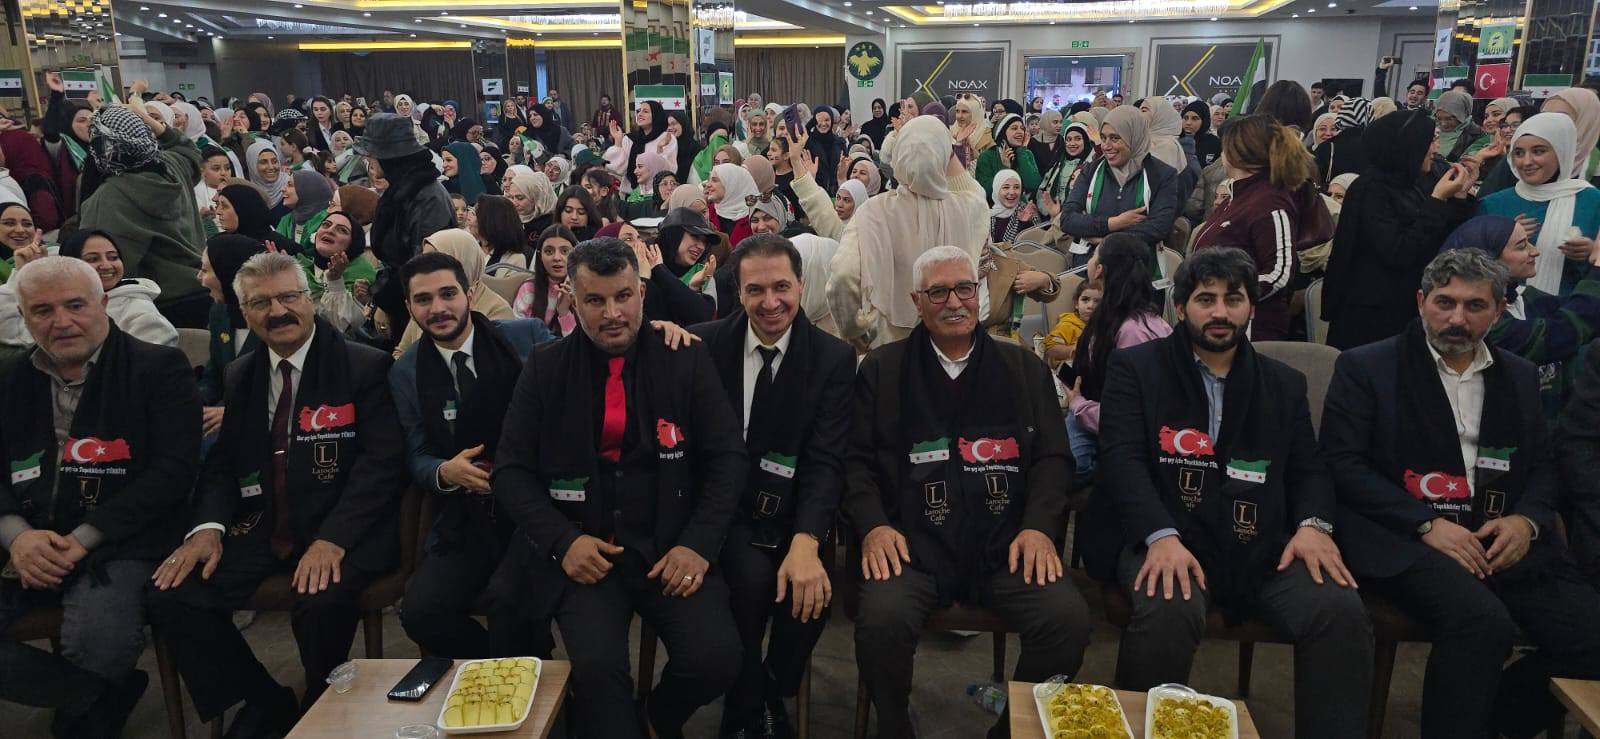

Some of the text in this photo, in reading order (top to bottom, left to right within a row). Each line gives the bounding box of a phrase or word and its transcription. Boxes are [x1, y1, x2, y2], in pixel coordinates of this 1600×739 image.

[948, 79, 989, 89] NOAX
[1209, 76, 1243, 86] NOA
[318, 445, 334, 464] L
[989, 476, 1005, 495] L
[1183, 471, 1198, 491] L
[929, 486, 943, 504] L
[1487, 494, 1500, 515] L
[1238, 504, 1253, 525] L
